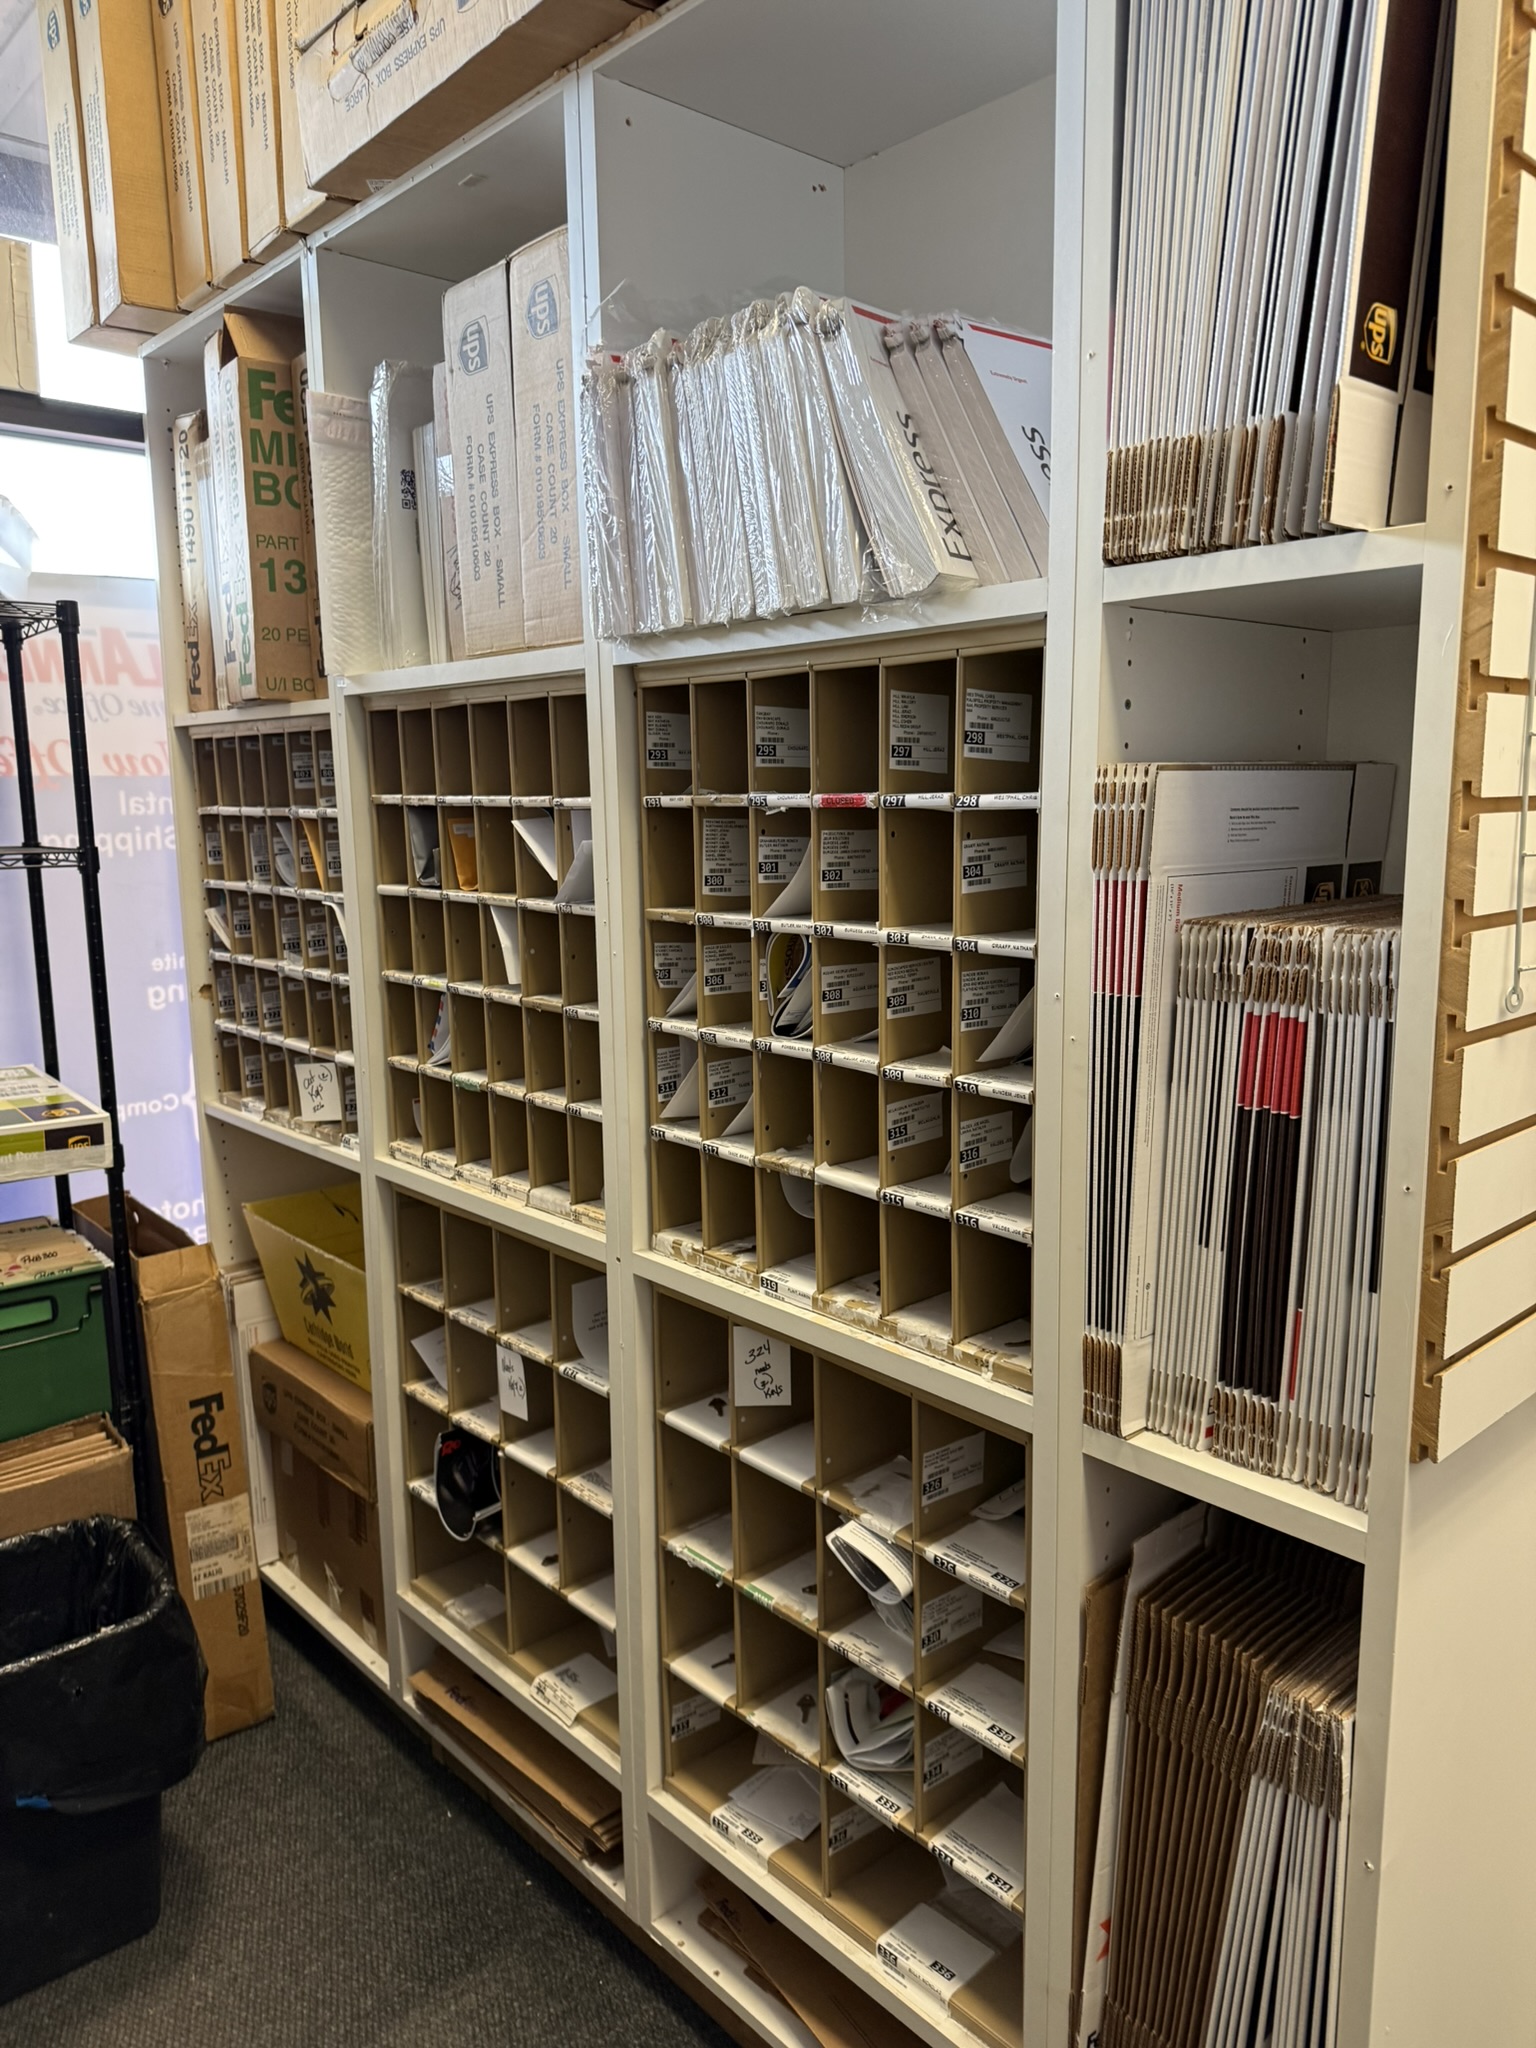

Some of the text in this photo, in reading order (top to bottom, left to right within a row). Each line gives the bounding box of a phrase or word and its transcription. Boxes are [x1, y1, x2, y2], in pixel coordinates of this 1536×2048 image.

[201, 32, 209, 72] FORM
[208, 36, 216, 74] CASE
[251, 38, 259, 90] COUNT
[345, 18, 446, 113] UPS EXPRESS BOX LARGE
[165, 69, 173, 108] FORM
[171, 72, 180, 105] CASE
[211, 78, 219, 125] COUNT
[213, 17, 230, 186] EXPRESS BOX MEDIUM
[172, 21, 194, 213] UPS EXPRESS BOX MEDIUM
[260, 92, 269, 150] MEDIUM
[174, 111, 183, 155] COUNT
[532, 403, 542, 447] FORM
[465, 435, 474, 478] FORM
[545, 411, 558, 545] CASE COUNT 20
[556, 357, 573, 590] UPS EXPRESS BOX SMALL
[477, 443, 492, 567] CASE COUNT 20
[486, 393, 506, 609] UPS EXPRESS BOX SMALL
[256, 534, 299, 551] PART
[234, 547, 253, 688] FedEx
[261, 627, 282, 643] 20
[186, 598, 203, 698] FedEx
[966, 732, 984, 744] 298
[650, 750, 667, 760] 293
[757, 745, 775, 756] 295
[893, 746, 911, 757] 297
[646, 798, 661, 808] 293
[751, 796, 767, 806] 295
[826, 796, 856, 806] CLOSED
[885, 796, 904, 808] 297
[956, 796, 978, 808] 298
[761, 863, 777, 872] 301
[964, 865, 983, 878] 304
[706, 876, 723, 885] 300
[824, 870, 841, 881] 302
[698, 915, 715, 926] 300
[755, 922, 770, 932] 301
[815, 925, 833, 936] 302
[889, 933, 908, 944] 303
[956, 940, 978, 952] 304
[706, 976, 723, 986] 306
[824, 990, 842, 1000] 308
[888, 995, 906, 1008] 309
[963, 1008, 979, 1021] 310
[701, 1033, 716, 1043] 306
[755, 1040, 771, 1050] 307
[815, 1052, 832, 1063] 308
[884, 1068, 902, 1081] 309
[660, 1082, 676, 1093] 311
[711, 1088, 728, 1099] 312
[956, 1082, 978, 1095] 310
[889, 1126, 907, 1139] 315
[961, 1149, 979, 1162] 316
[884, 1193, 903, 1206] 315
[957, 1215, 978, 1228] 316
[761, 1277, 777, 1292] 319
[744, 1338, 772, 1366] 324
[188, 1391, 233, 1499] FedEx
[923, 1479, 942, 1495] 326
[934, 1555, 956, 1575] 326
[992, 1572, 1018, 1589] 326
[988, 1723, 1016, 1744] 330
[986, 1873, 1013, 1893] 334
[930, 1960, 956, 1982] 336
